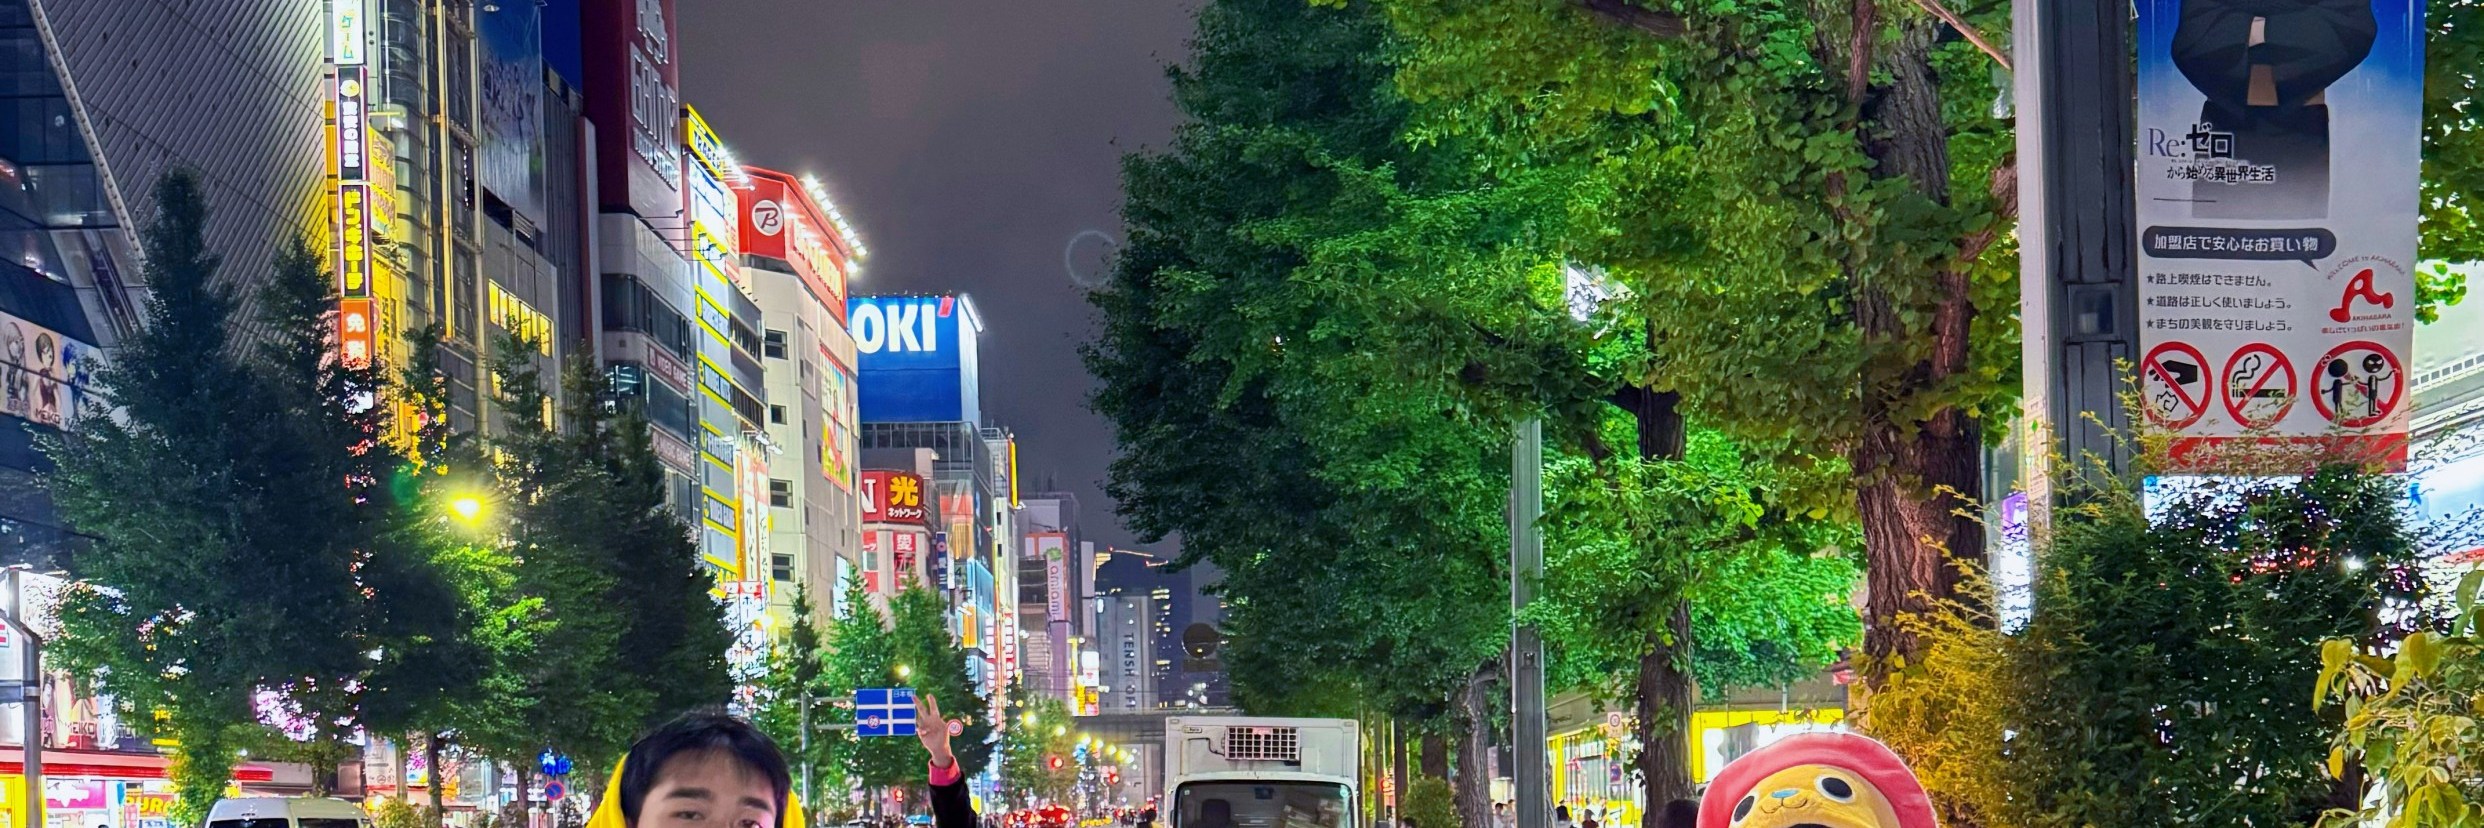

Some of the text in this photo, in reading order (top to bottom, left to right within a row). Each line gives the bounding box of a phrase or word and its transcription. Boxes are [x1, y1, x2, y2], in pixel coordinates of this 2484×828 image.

[2148, 122, 2234, 158] Re:ゼロ
[2167, 164, 2275, 184] から始める異世界生活
[2154, 233, 2319, 253] 加盟店で安心なお買い物
[2156, 273, 2272, 287] 路上喫煙はできません。
[2156, 296, 2292, 310] 道路は正しく使いましょう。
[2156, 318, 2293, 332] まちの美観を守りましょう。
[890, 476, 919, 506] 光
[887, 507, 922, 518] ネットワーク
